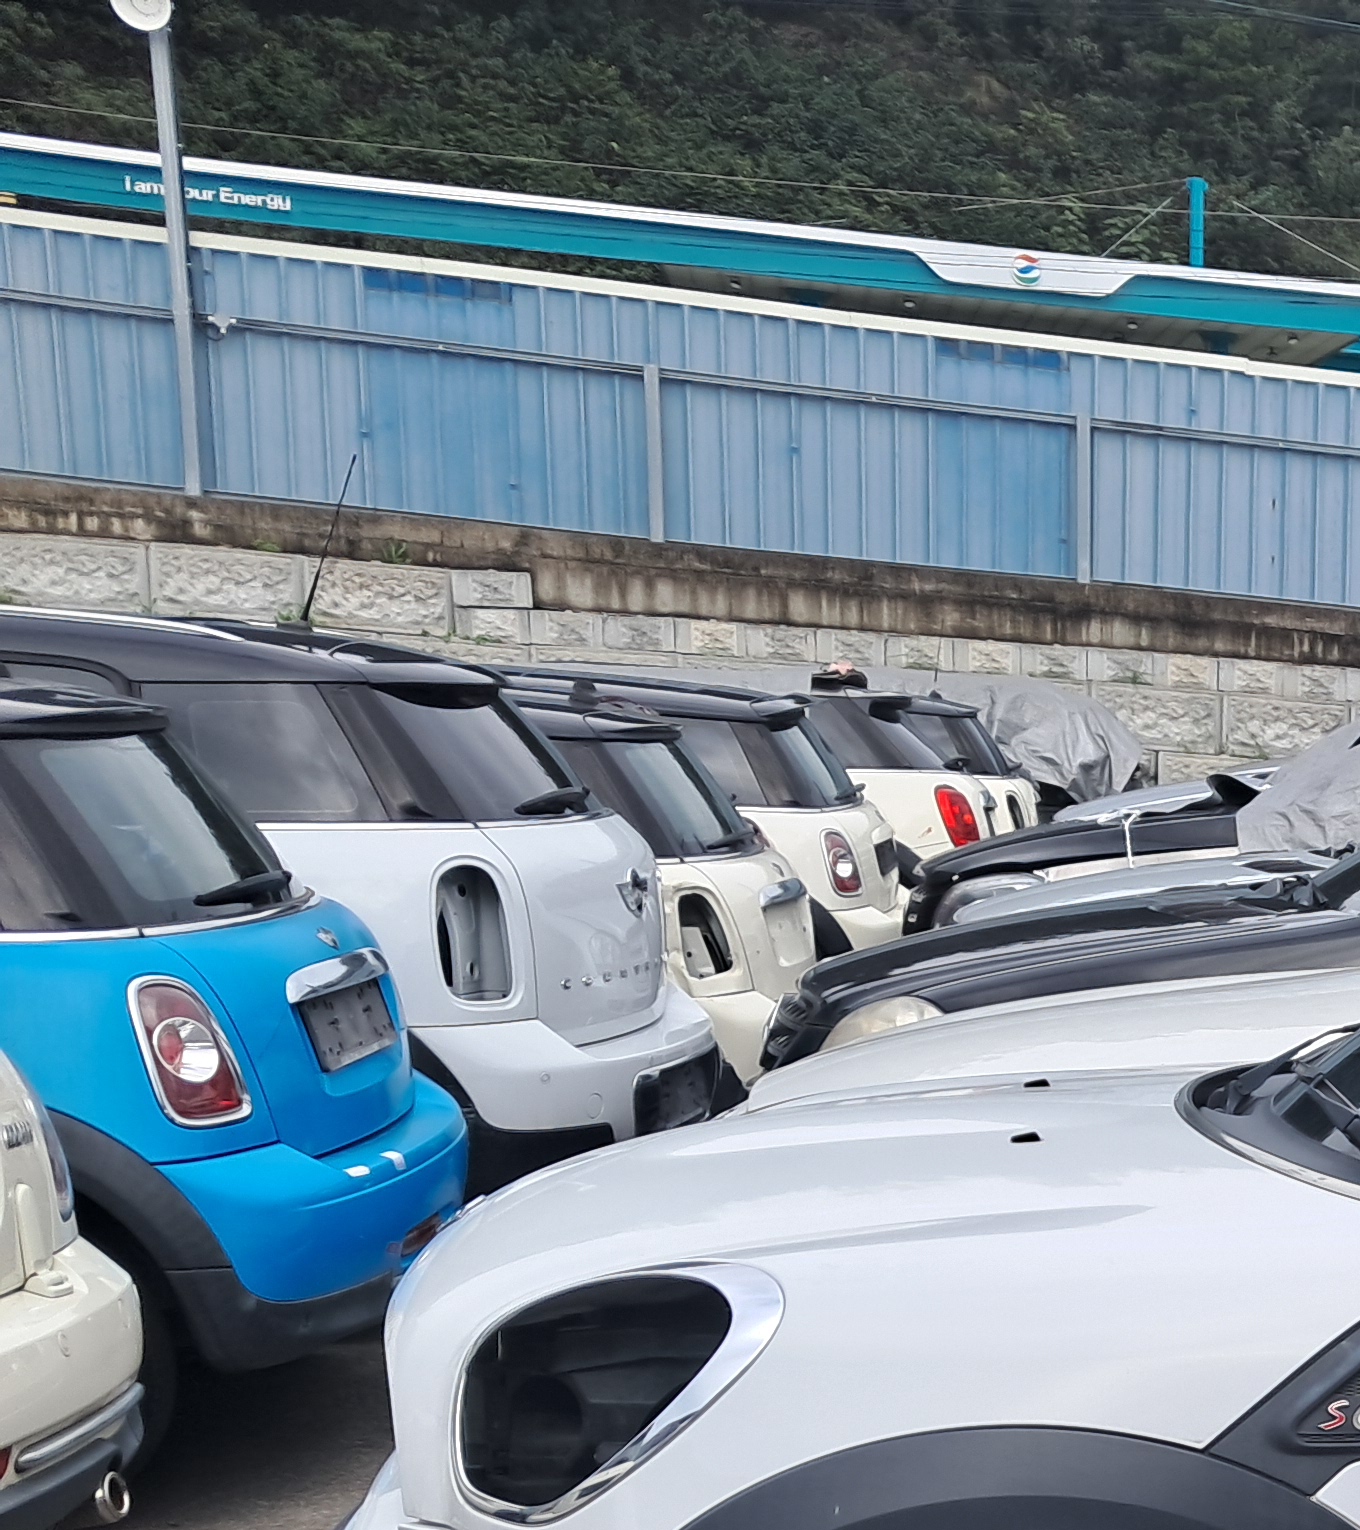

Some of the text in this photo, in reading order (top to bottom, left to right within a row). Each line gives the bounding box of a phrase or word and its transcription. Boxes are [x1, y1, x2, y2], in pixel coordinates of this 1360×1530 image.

[184, 186, 217, 202] our
[218, 187, 292, 211] Energy
[1318, 1399, 1350, 1430] S
